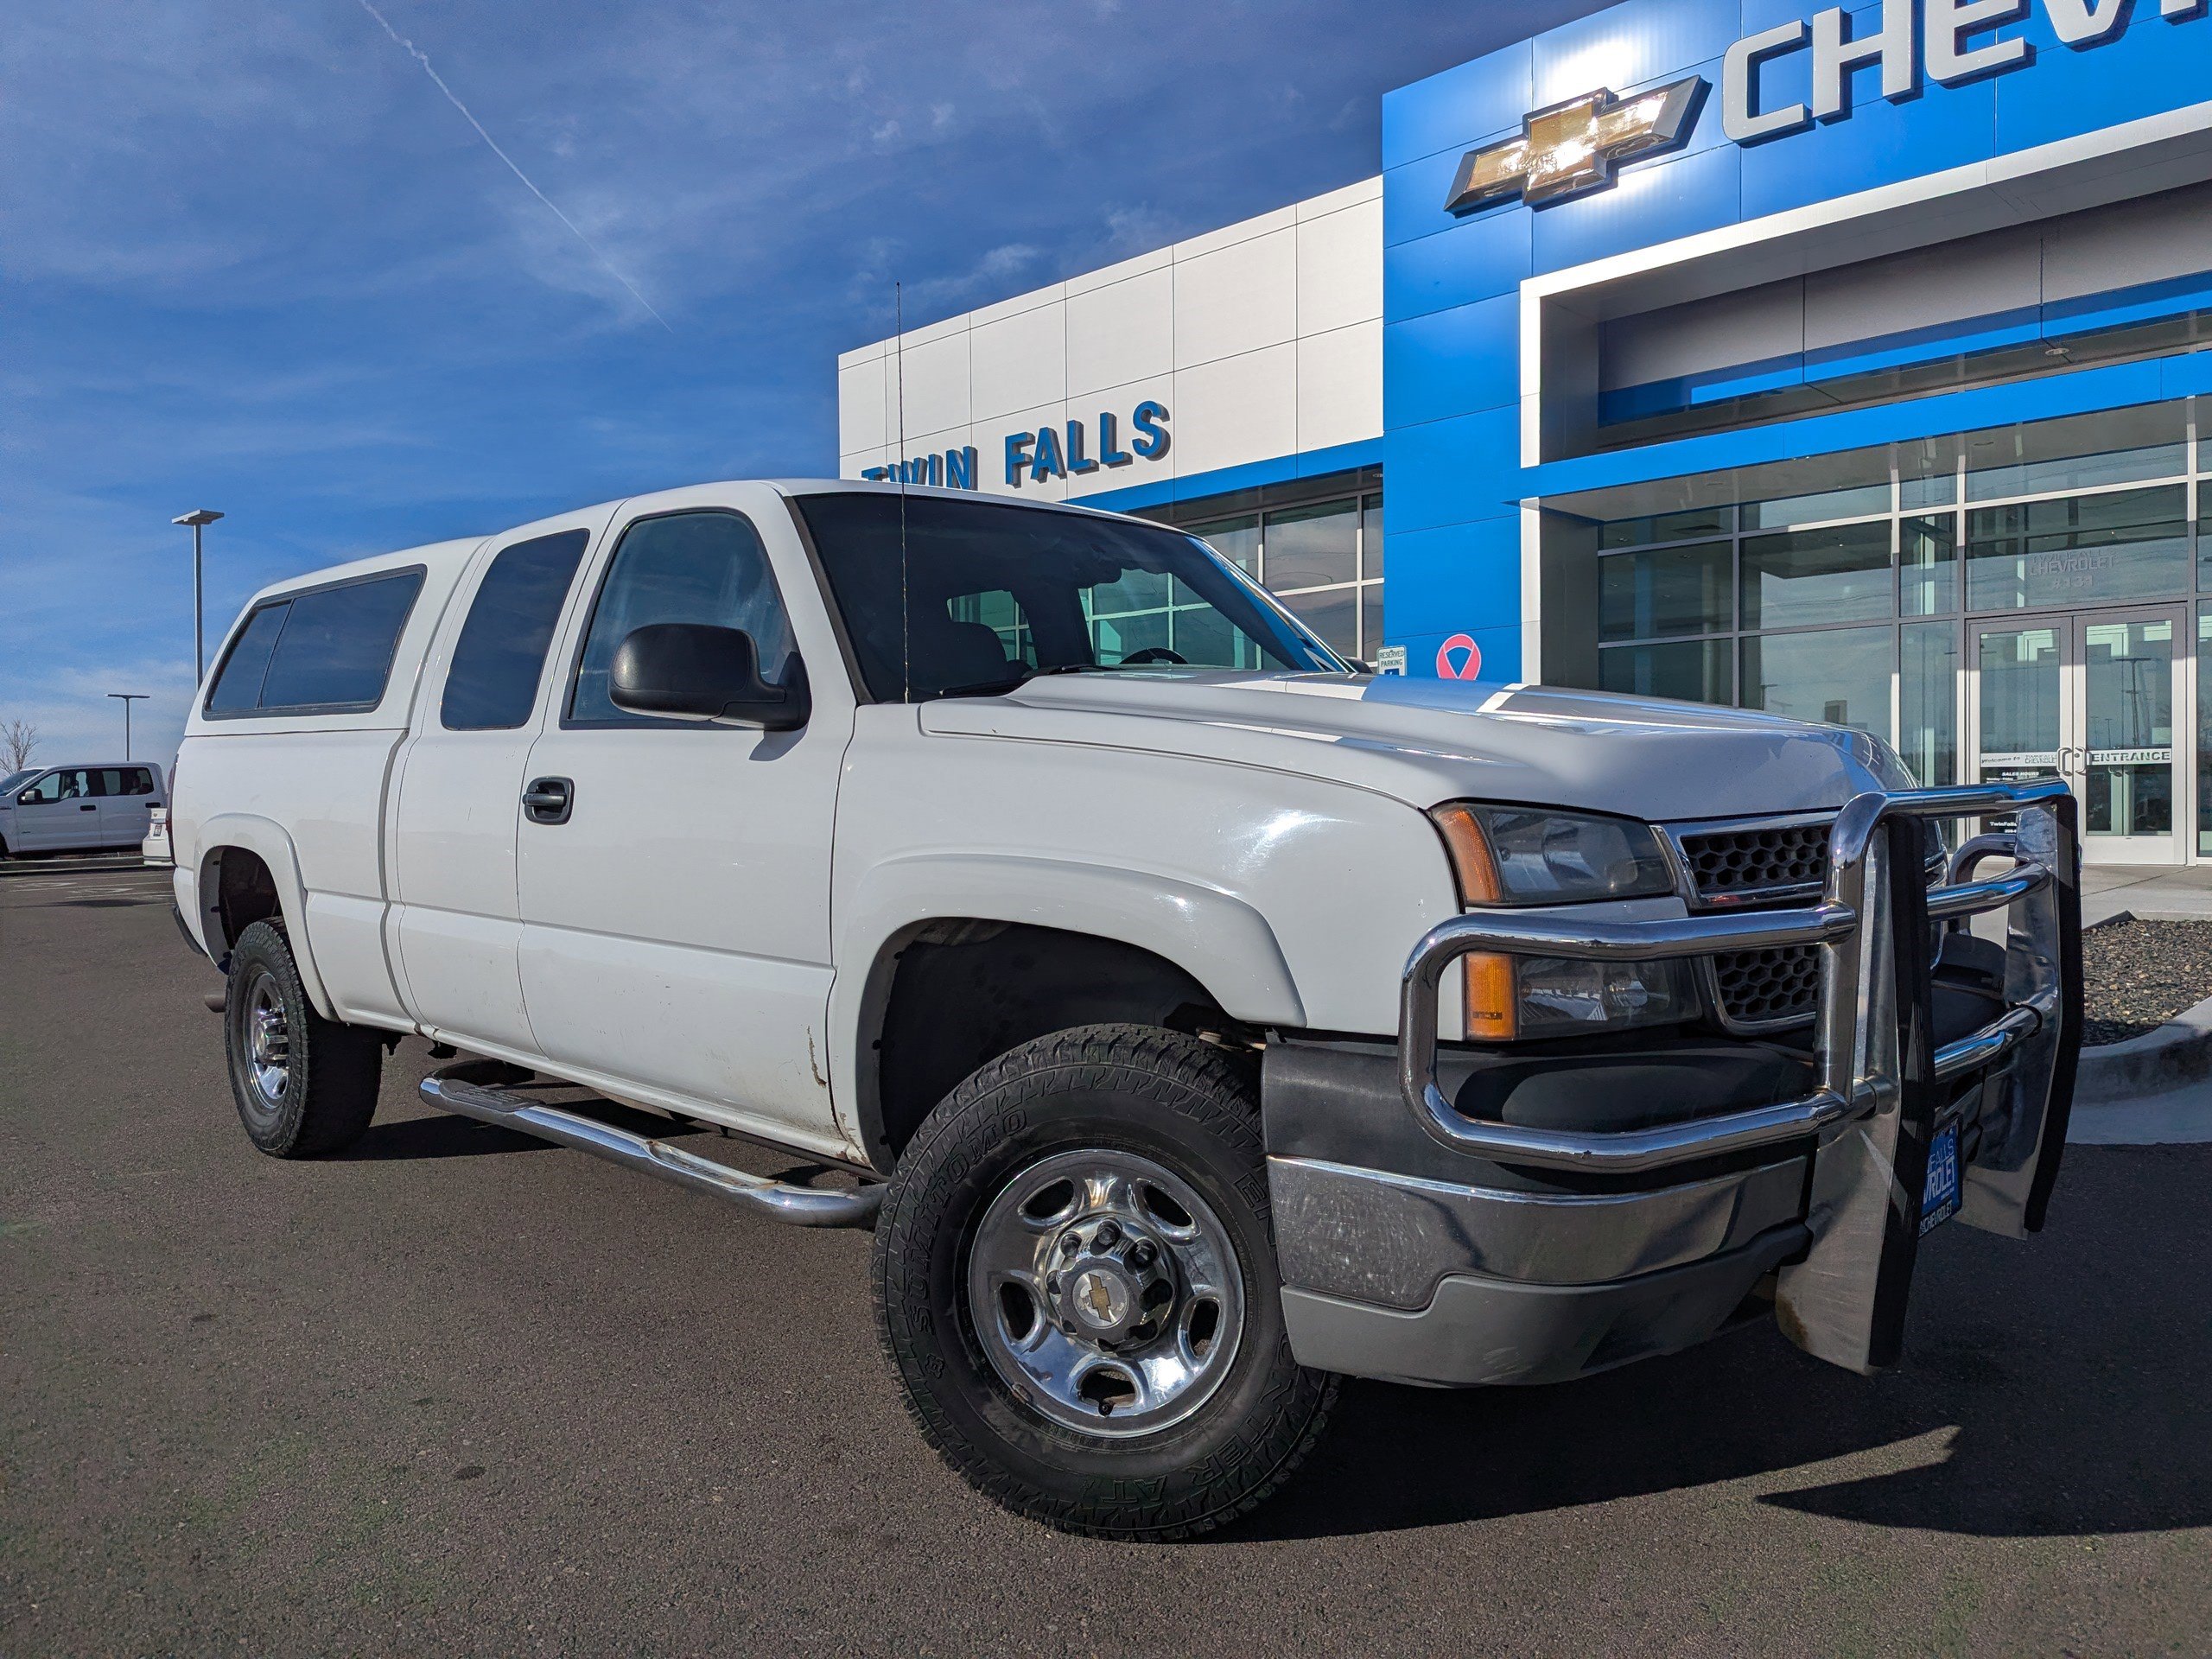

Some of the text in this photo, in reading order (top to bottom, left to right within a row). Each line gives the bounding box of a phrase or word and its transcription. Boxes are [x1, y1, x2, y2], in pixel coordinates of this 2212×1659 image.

[1723, 0, 2202, 145] CHE
[1005, 400, 1170, 489] FALLS
[1379, 650, 1404, 659] RESERVED
[2091, 751, 2171, 762] ENTRANCE
[906, 1108, 1027, 1335] SUMITOMO
